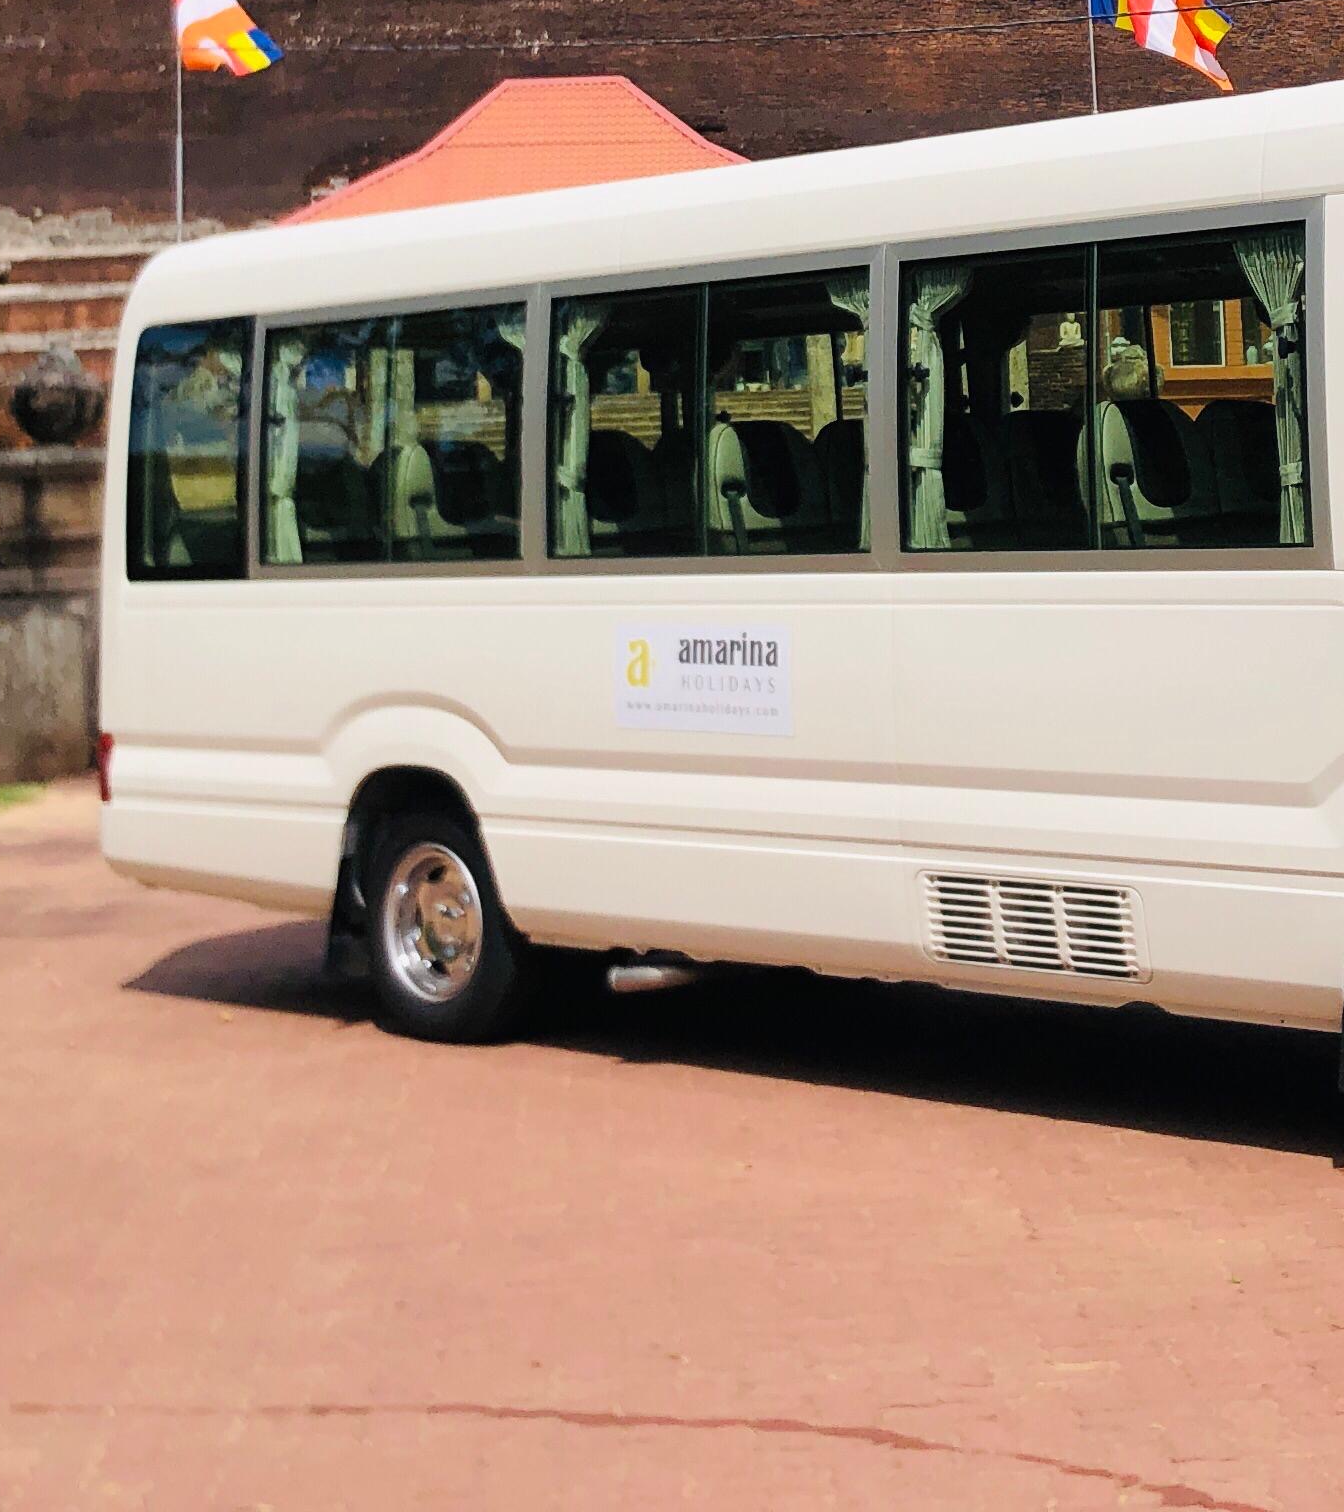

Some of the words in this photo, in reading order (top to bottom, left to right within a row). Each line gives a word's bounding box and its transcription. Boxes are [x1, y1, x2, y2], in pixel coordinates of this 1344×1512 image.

[625, 638, 651, 688] a
[678, 631, 779, 668] amarina
[681, 674, 777, 694] HOLIDAYS
